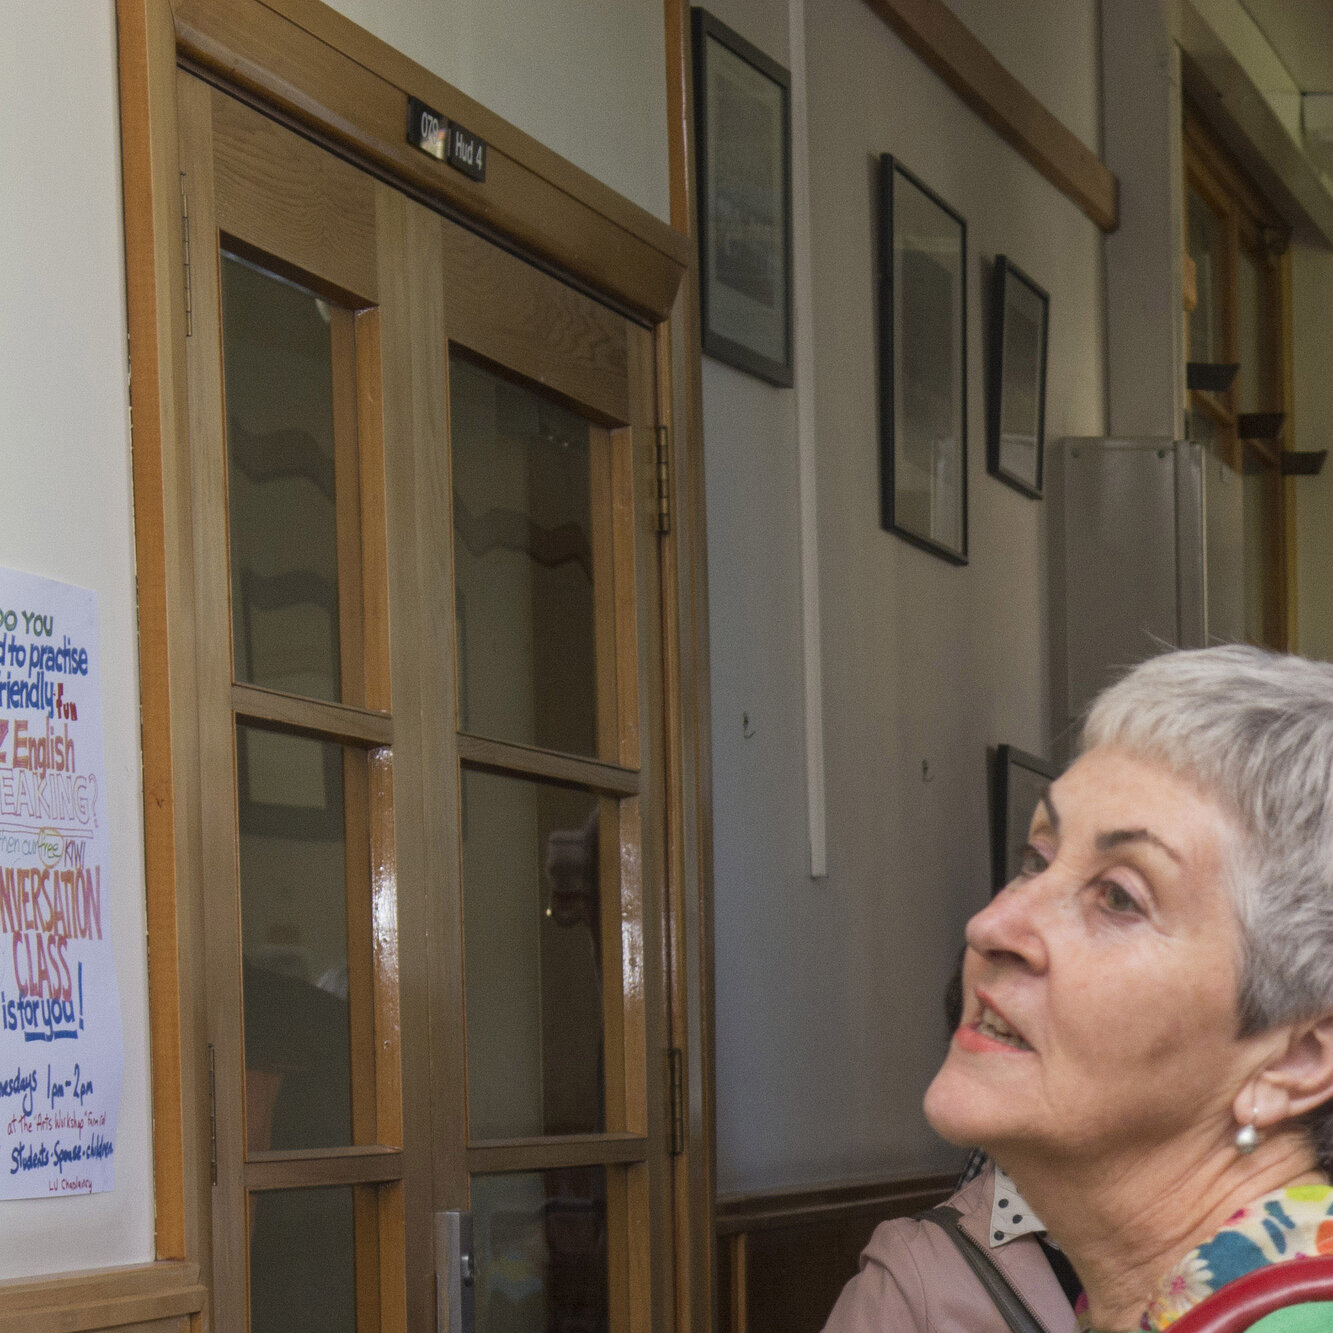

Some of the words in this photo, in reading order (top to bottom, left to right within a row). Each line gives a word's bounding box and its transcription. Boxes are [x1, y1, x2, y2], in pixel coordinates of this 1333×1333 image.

[475, 145, 483, 171] 4
[0, 608, 18, 632] O
[22, 610, 54, 637] YOU
[8, 634, 27, 668] to
[28, 634, 89, 679] practise
[13, 716, 75, 781] English
[12, 931, 73, 1003] CLASS
[1, 991, 18, 1031] is
